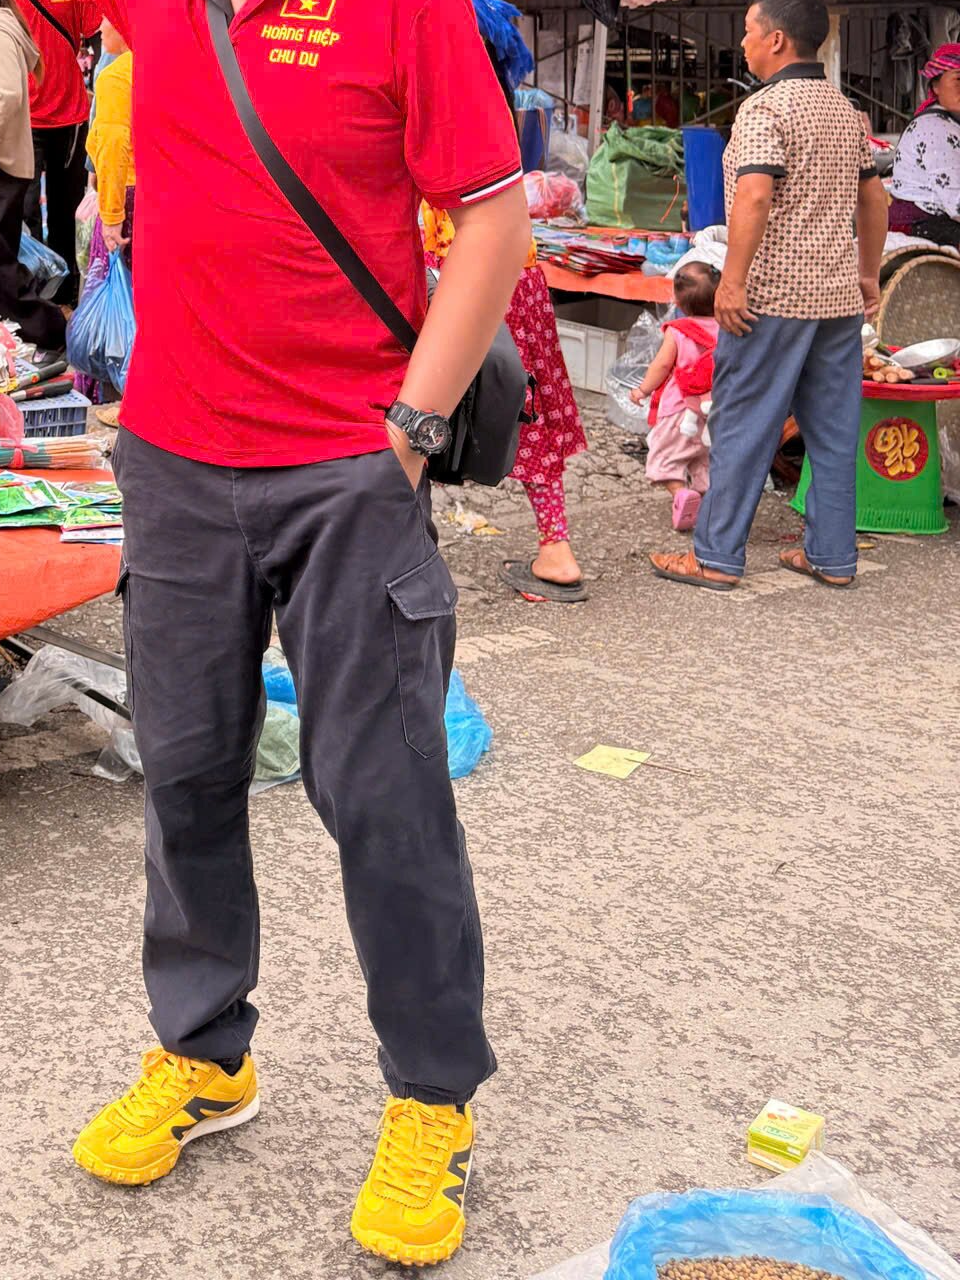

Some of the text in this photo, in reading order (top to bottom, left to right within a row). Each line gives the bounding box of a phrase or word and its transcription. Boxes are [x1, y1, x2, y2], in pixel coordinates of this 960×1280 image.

[261, 25, 340, 46] HOÀNG HIỆP
[268, 48, 320, 67] CHU DU
